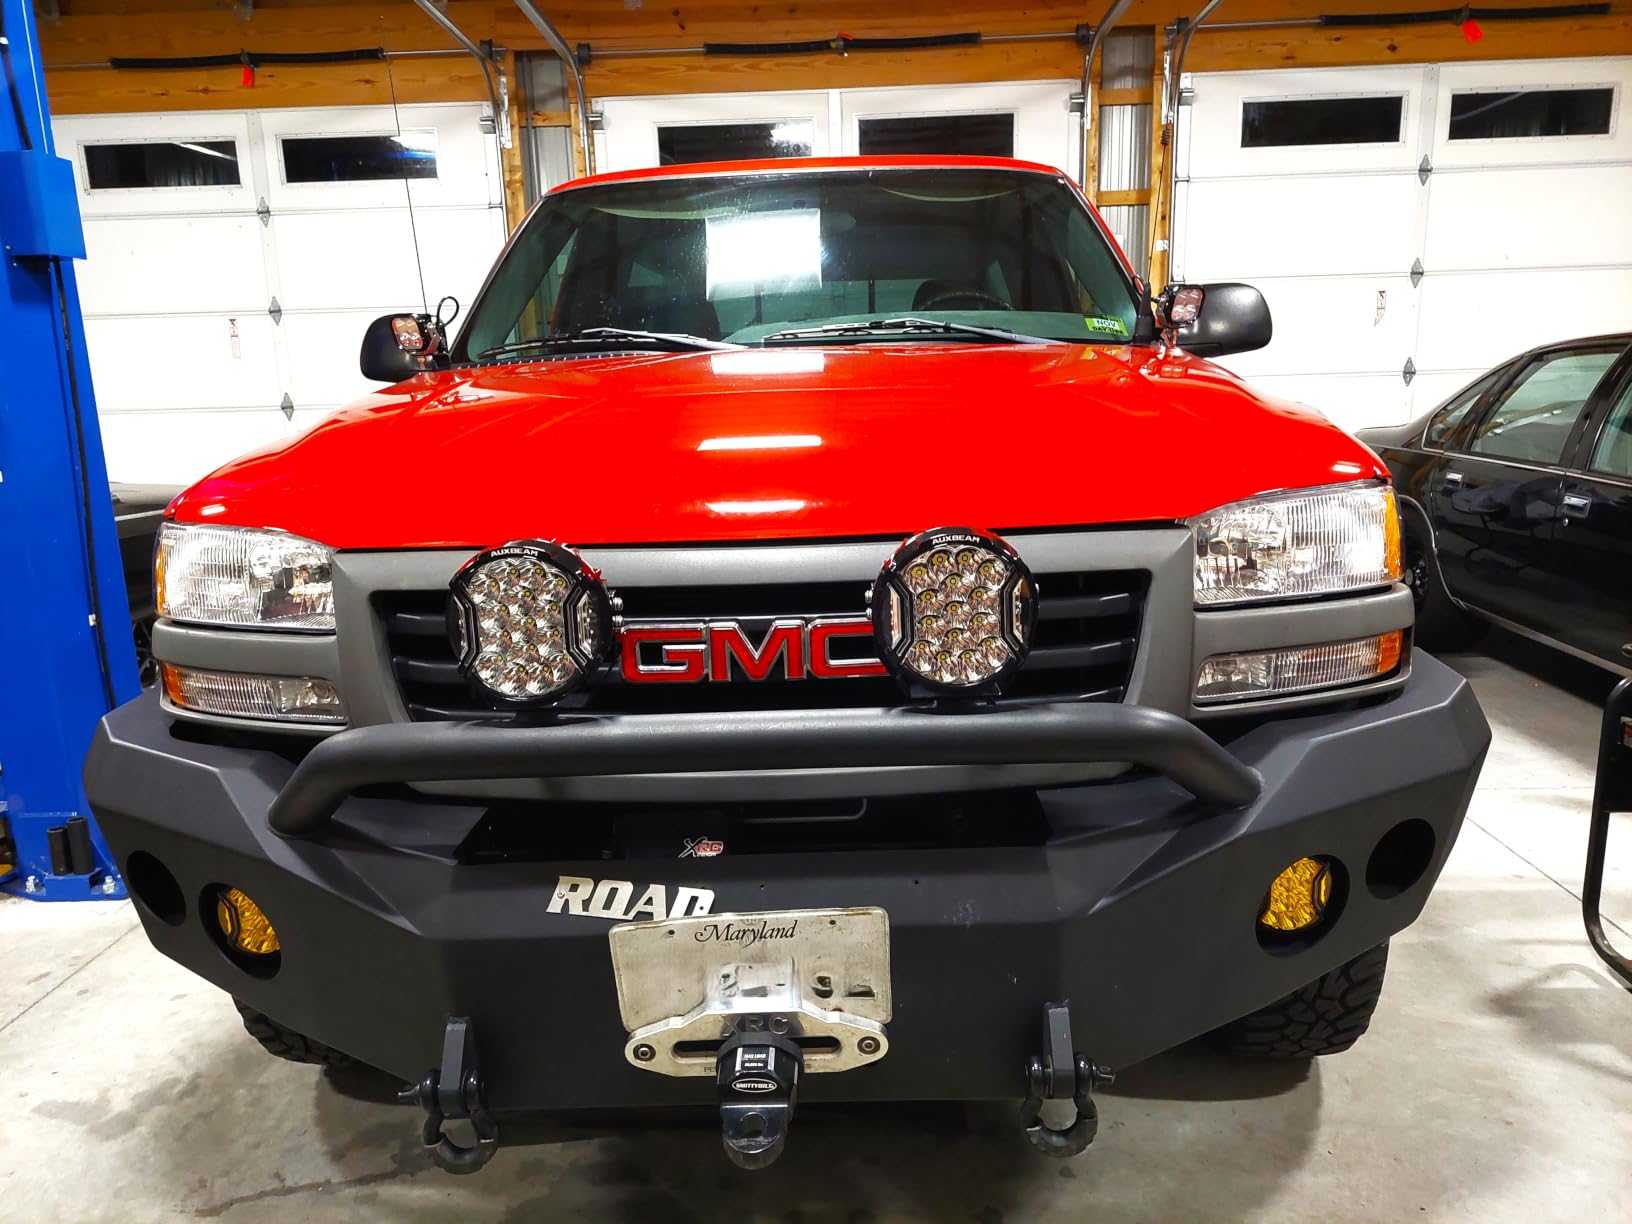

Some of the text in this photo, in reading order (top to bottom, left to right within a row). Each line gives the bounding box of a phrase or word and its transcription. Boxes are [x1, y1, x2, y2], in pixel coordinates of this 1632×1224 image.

[1096, 319, 1116, 328] NOV
[931, 534, 980, 545] AUXBEAM
[490, 547, 539, 558] AUXBEAM
[619, 617, 889, 683] GMC
[545, 875, 716, 921] ROAD
[694, 919, 798, 948] Maryland
